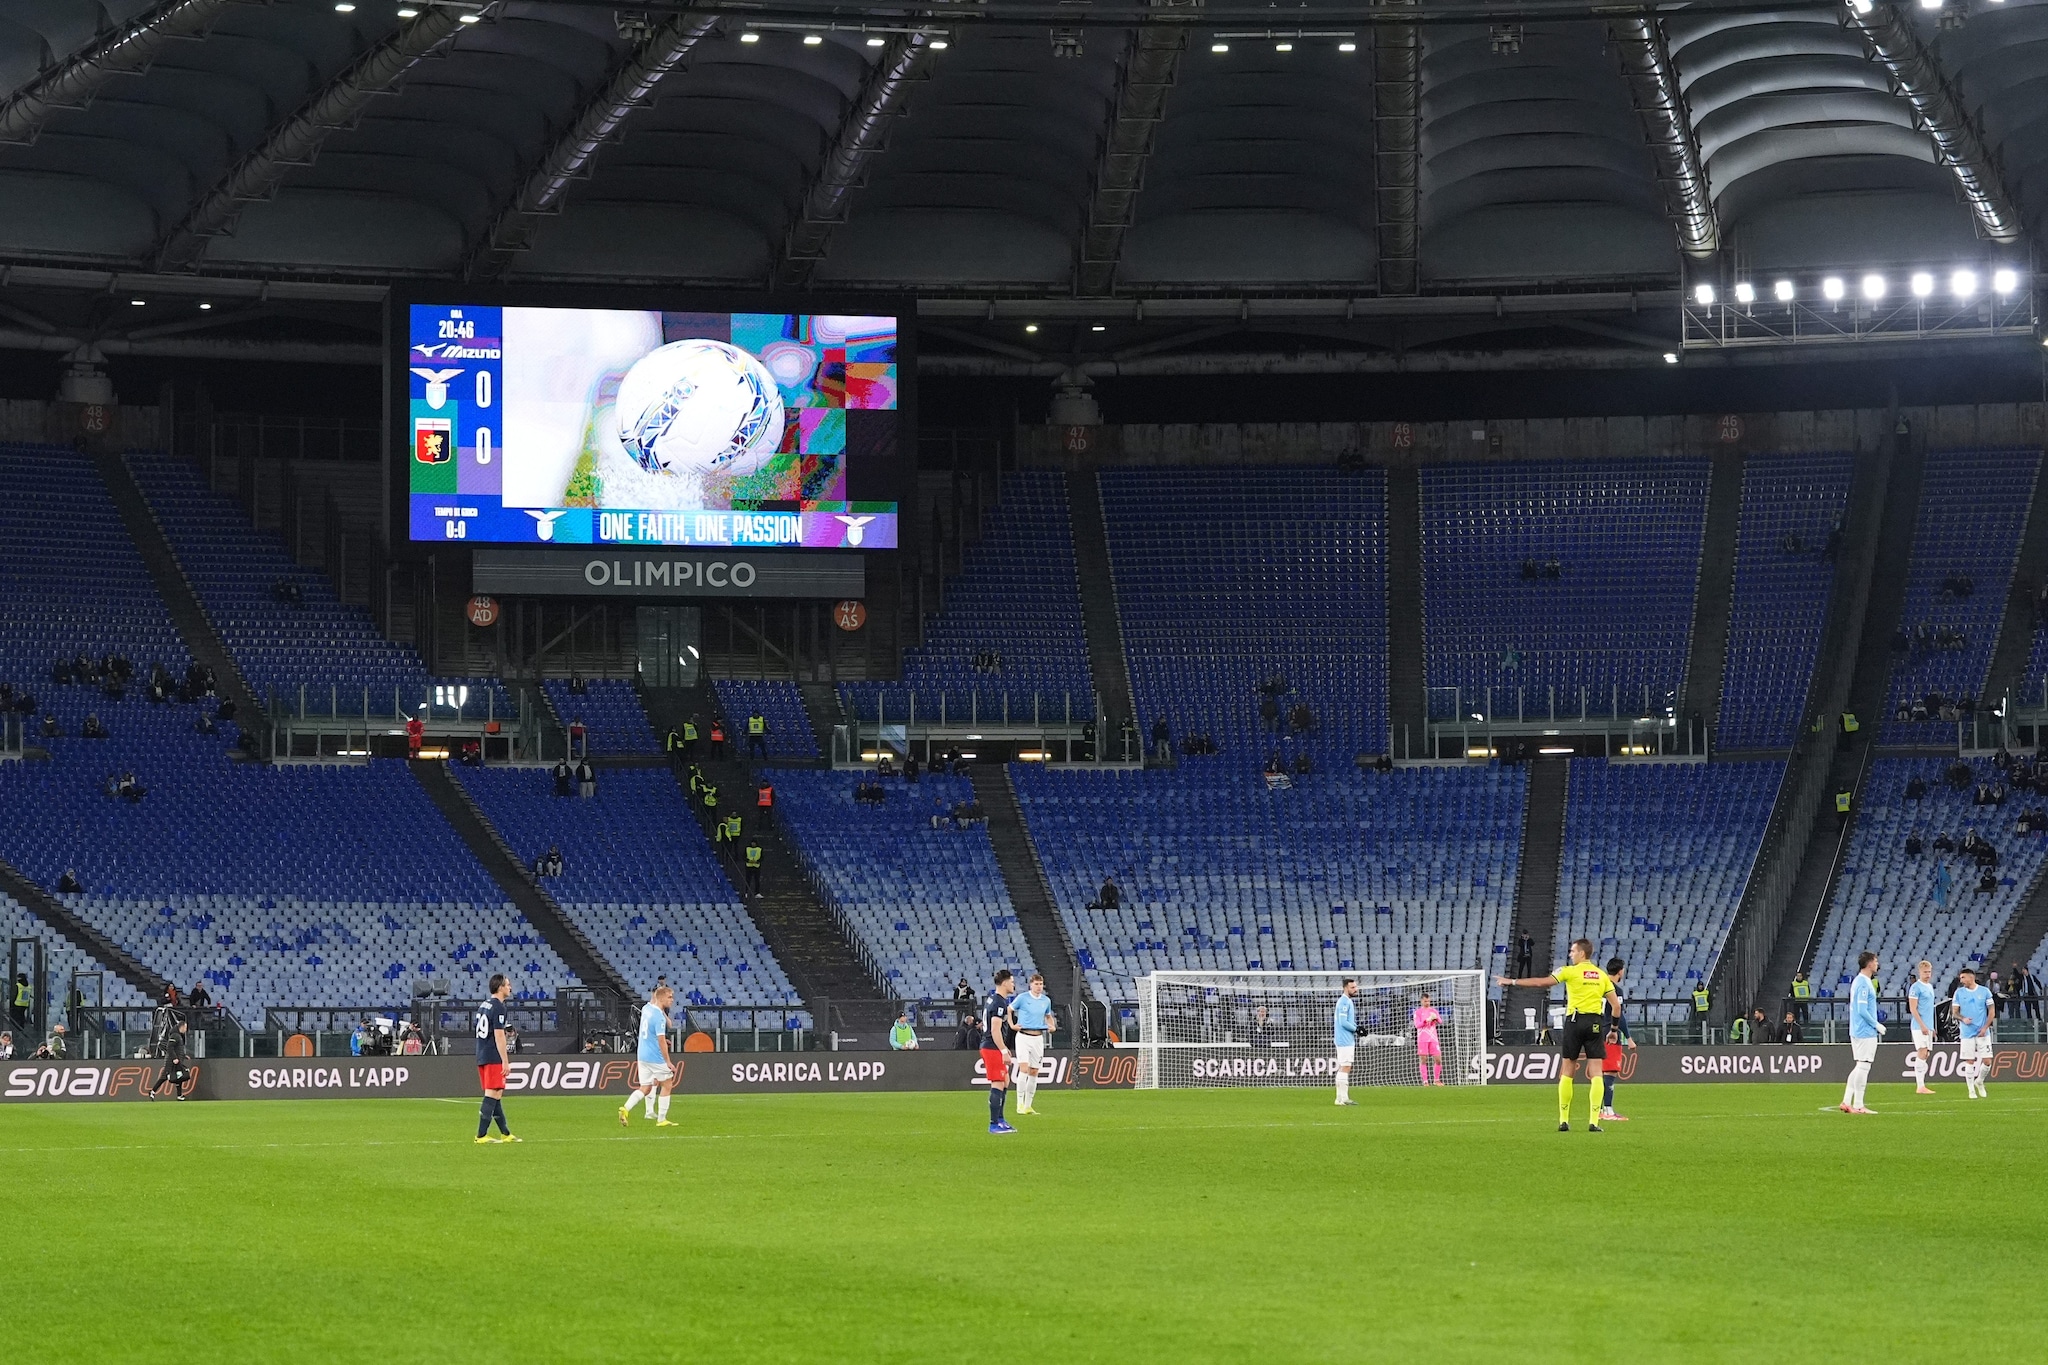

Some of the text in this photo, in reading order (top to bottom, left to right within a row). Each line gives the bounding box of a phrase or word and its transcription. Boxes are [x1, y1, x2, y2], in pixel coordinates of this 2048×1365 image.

[439, 320, 475, 339] 20:46
[476, 370, 492, 409] 0
[87, 418, 103, 431] AS
[1722, 415, 1738, 428] 46
[1070, 426, 1085, 438] 47
[1394, 423, 1410, 435] 46
[1720, 428, 1739, 440] AD
[476, 426, 492, 465] 0
[1069, 438, 1087, 450] AD
[1394, 435, 1412, 448] AS
[446, 520, 466, 539] 0:0
[600, 513, 803, 545] ONE FAITH, ONE PASSION
[584, 560, 757, 588] OLIMPICO
[474, 596, 491, 608] 48
[841, 600, 858, 614] 47
[472, 609, 493, 622] AD
[840, 614, 859, 627] AS
[248, 1068, 342, 1088] SCARICA
[350, 1067, 409, 1088] L'APP
[732, 1063, 822, 1083] SCARICA
[828, 1061, 886, 1081] L'APP
[1193, 1058, 1278, 1078] SCARICA
[1286, 1058, 1341, 1077] L'APP
[1681, 1055, 1764, 1074] SCARICA
[1770, 1055, 1823, 1074] L'APP
